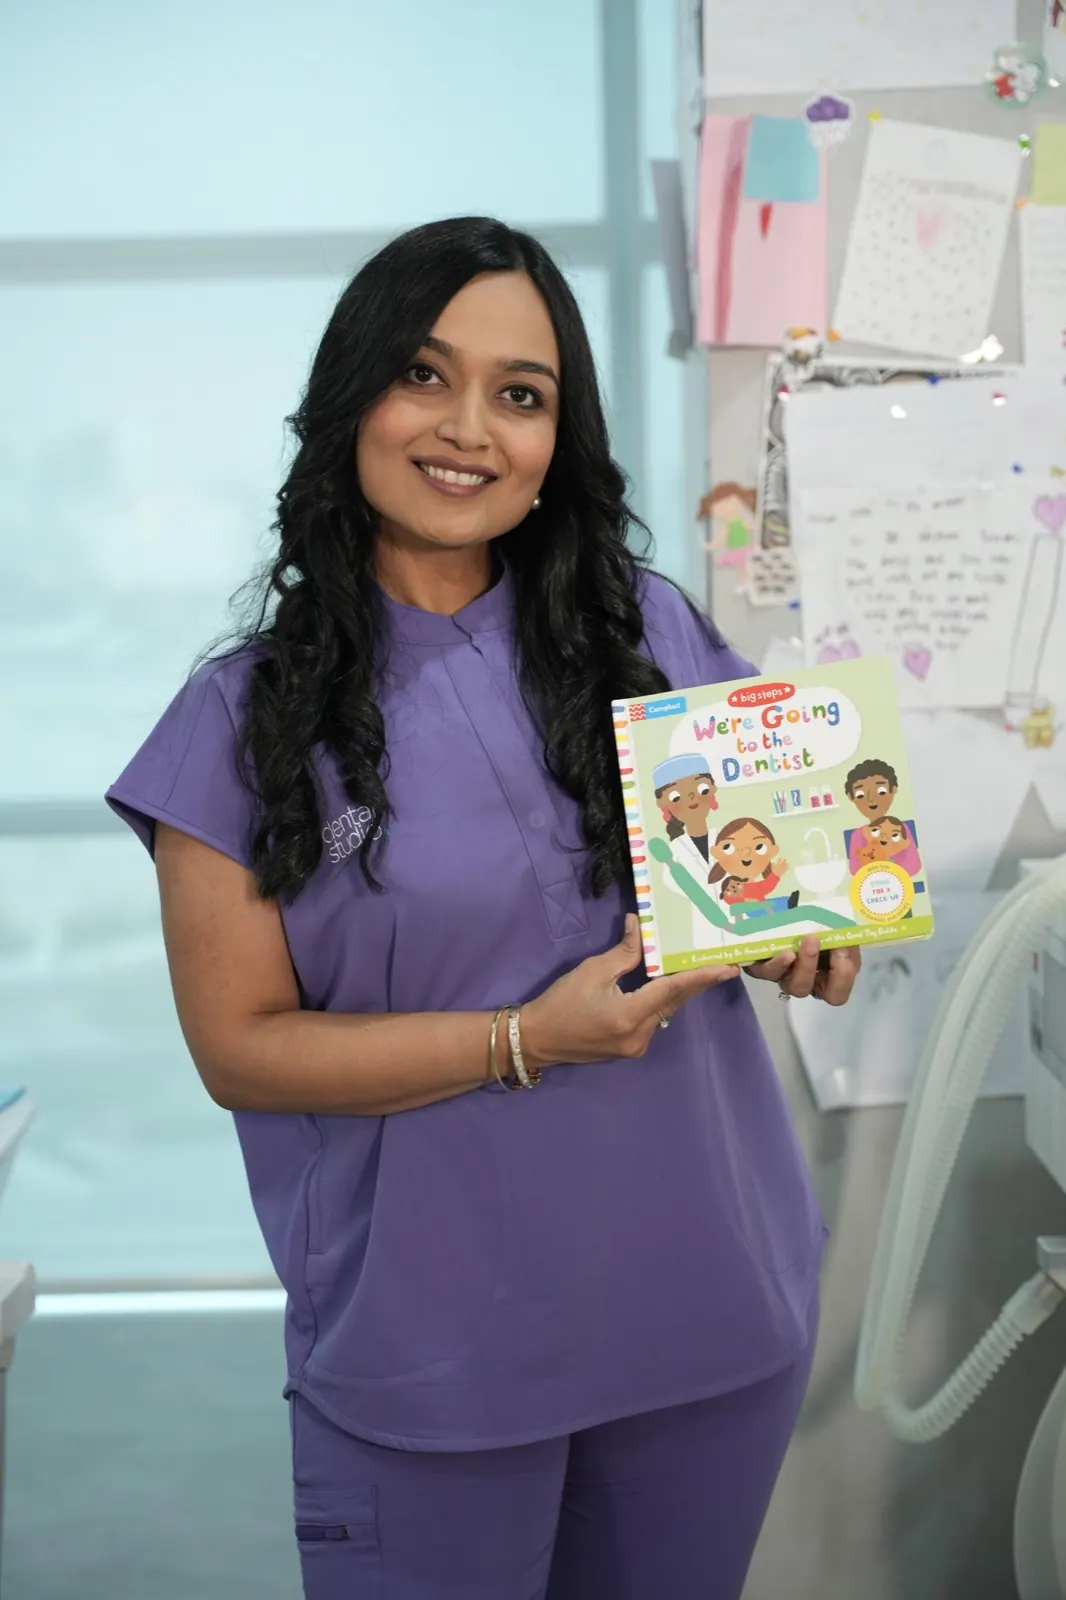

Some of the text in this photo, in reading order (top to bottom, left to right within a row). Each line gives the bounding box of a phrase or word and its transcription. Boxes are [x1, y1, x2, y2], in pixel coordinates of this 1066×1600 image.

[741, 688, 783, 703] big steps
[693, 701, 840, 741] We're Going
[737, 732, 793, 753] to the
[722, 748, 815, 782] Dentist
